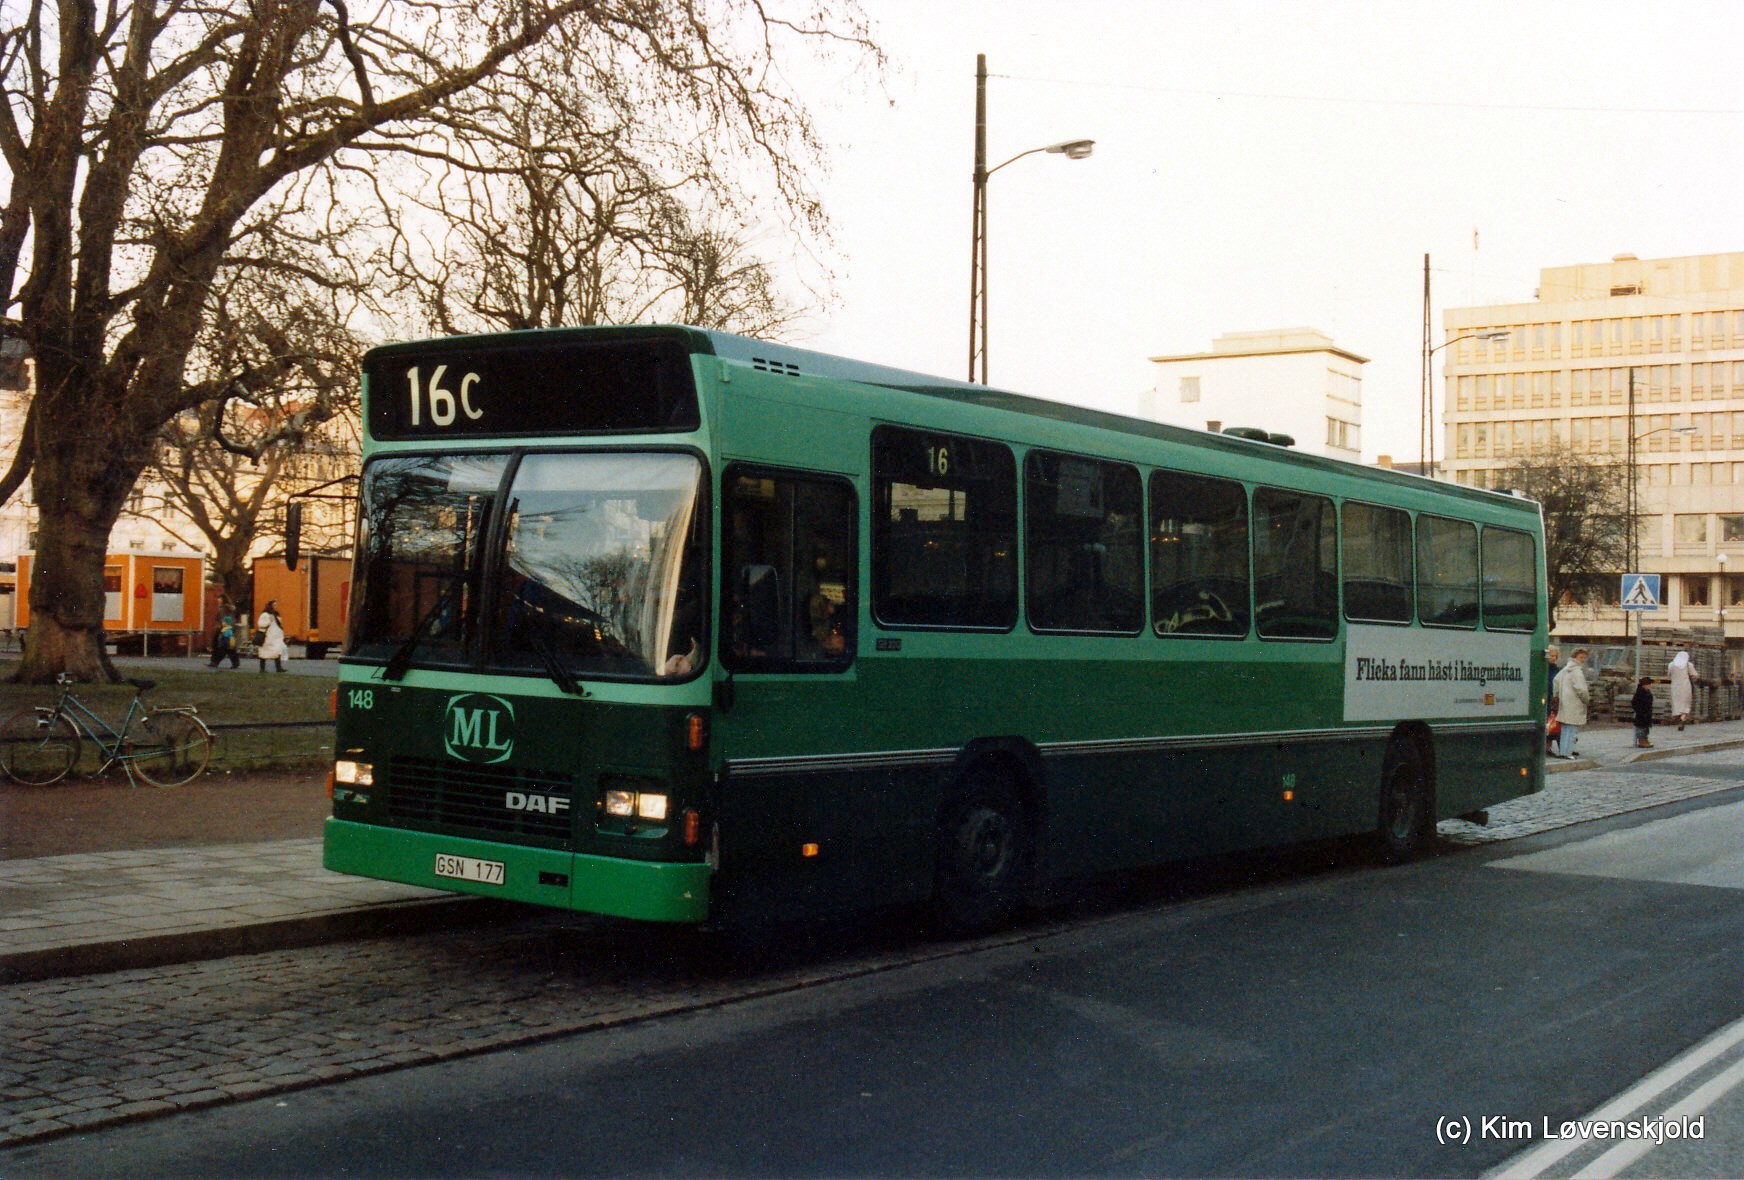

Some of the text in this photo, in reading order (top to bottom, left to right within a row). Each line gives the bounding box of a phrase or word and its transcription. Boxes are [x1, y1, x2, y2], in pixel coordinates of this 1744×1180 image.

[928, 446, 948, 476] 16
[1356, 657, 1524, 687] Flicka fann häst i hängmattan.
[348, 690, 374, 710] 148
[451, 706, 511, 751] ML
[505, 791, 571, 815] DAF
[437, 856, 504, 882] GSN 177
